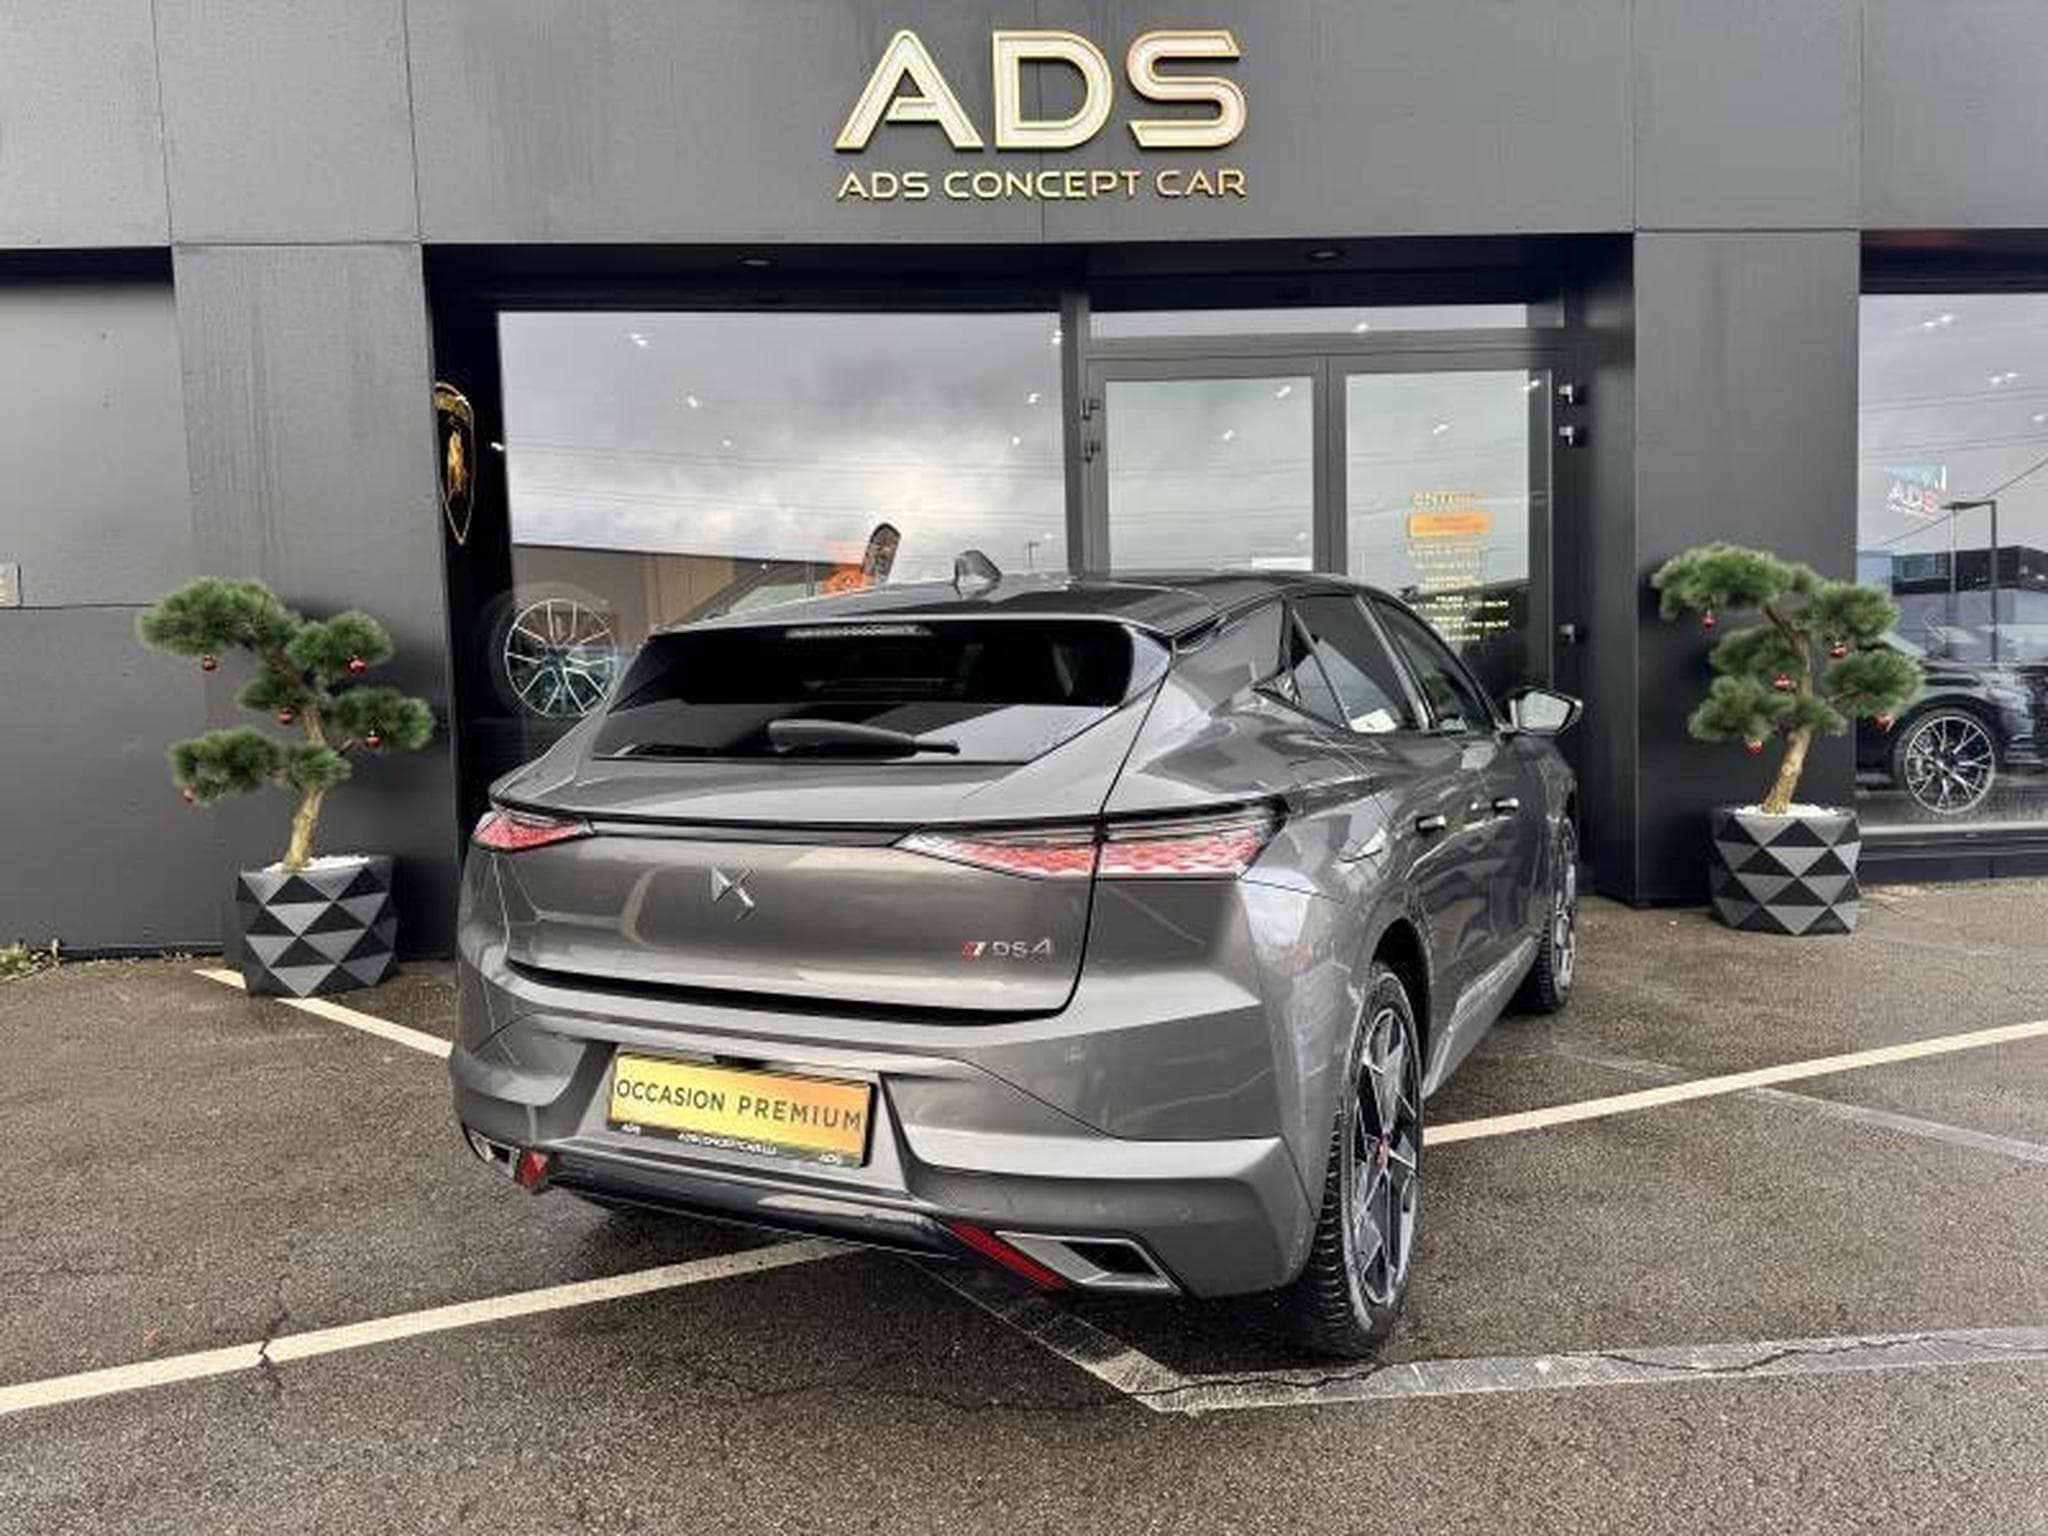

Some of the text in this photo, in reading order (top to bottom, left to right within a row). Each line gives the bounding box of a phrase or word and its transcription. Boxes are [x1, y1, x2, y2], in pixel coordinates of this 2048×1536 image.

[834, 29, 1248, 151] ADS
[838, 169, 1247, 199] ADS CONCEPT CAR
[615, 1078, 862, 1131] OCCASION PREMIUM
